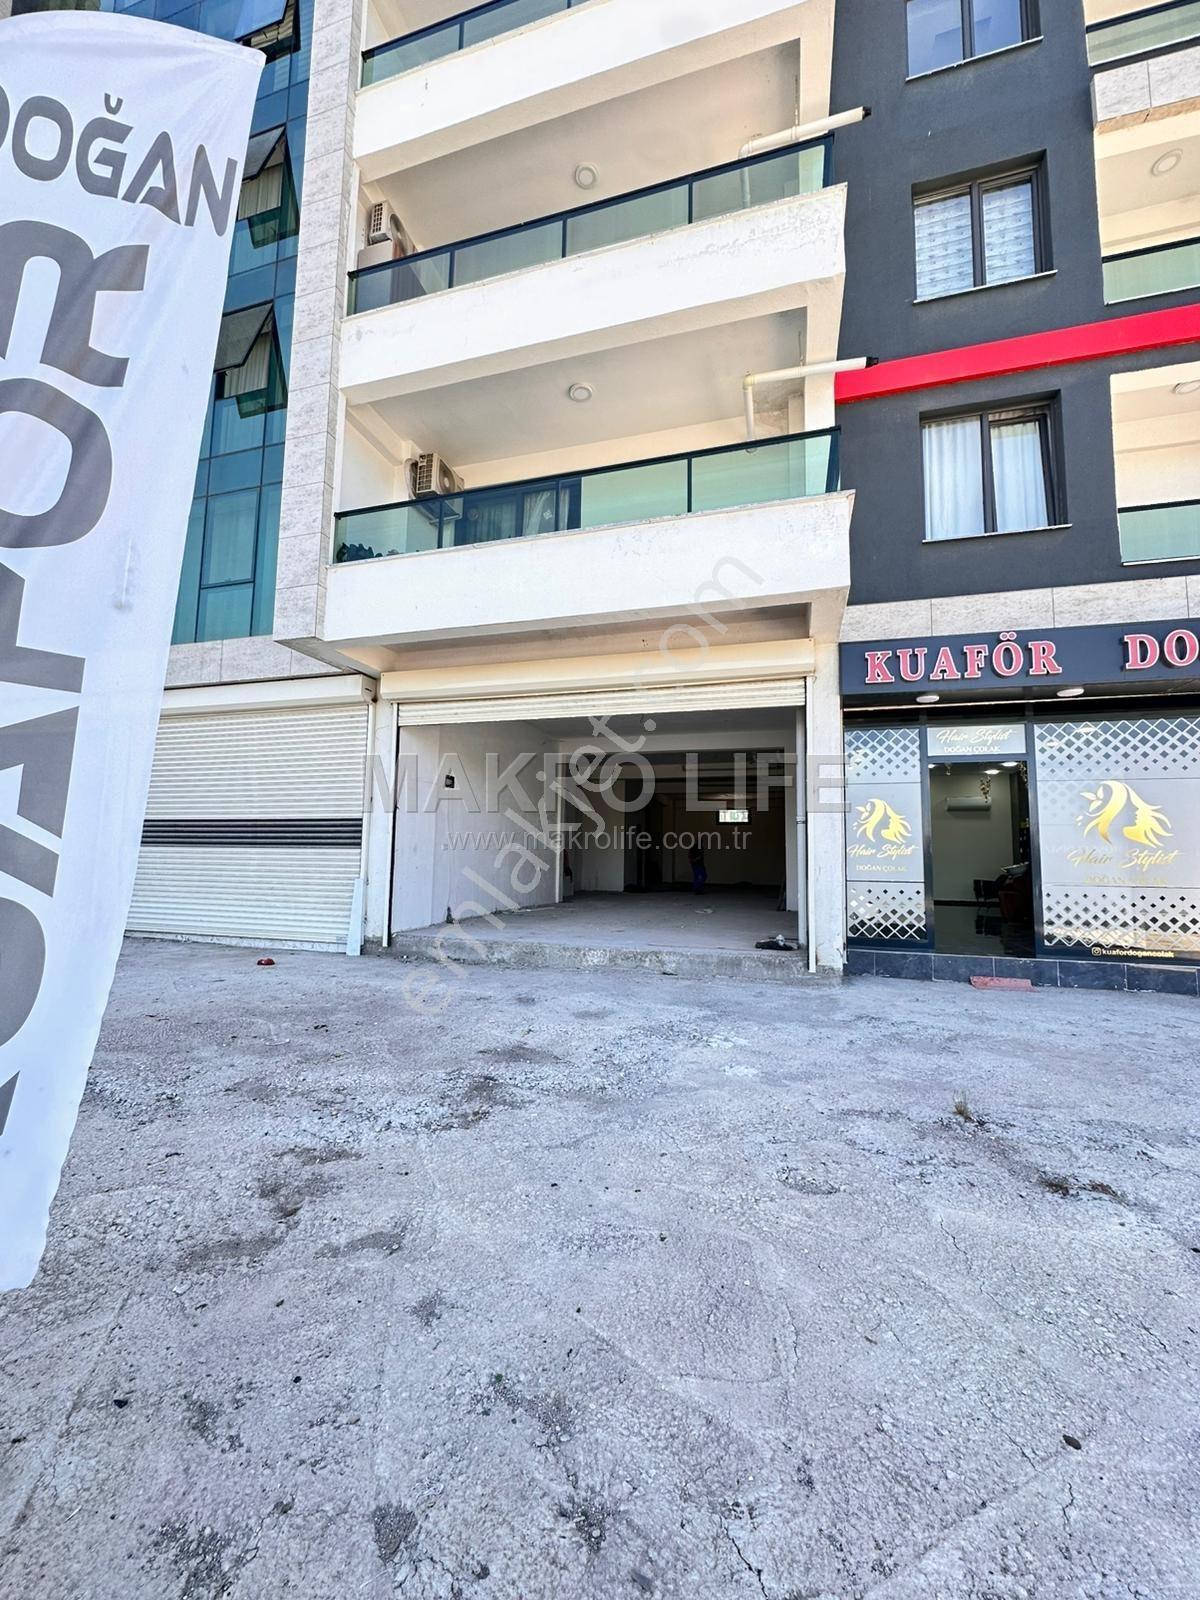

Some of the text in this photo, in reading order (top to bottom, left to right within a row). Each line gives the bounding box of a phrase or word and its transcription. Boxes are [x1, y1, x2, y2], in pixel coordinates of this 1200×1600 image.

[0, 84, 237, 237] OĞAN
[865, 629, 1199, 684] KUAFÖR DO
[936, 728, 1015, 745] Hair Stylist
[847, 843, 919, 860] Hair Stylist
[1120, 848, 1185, 872] Stylist
